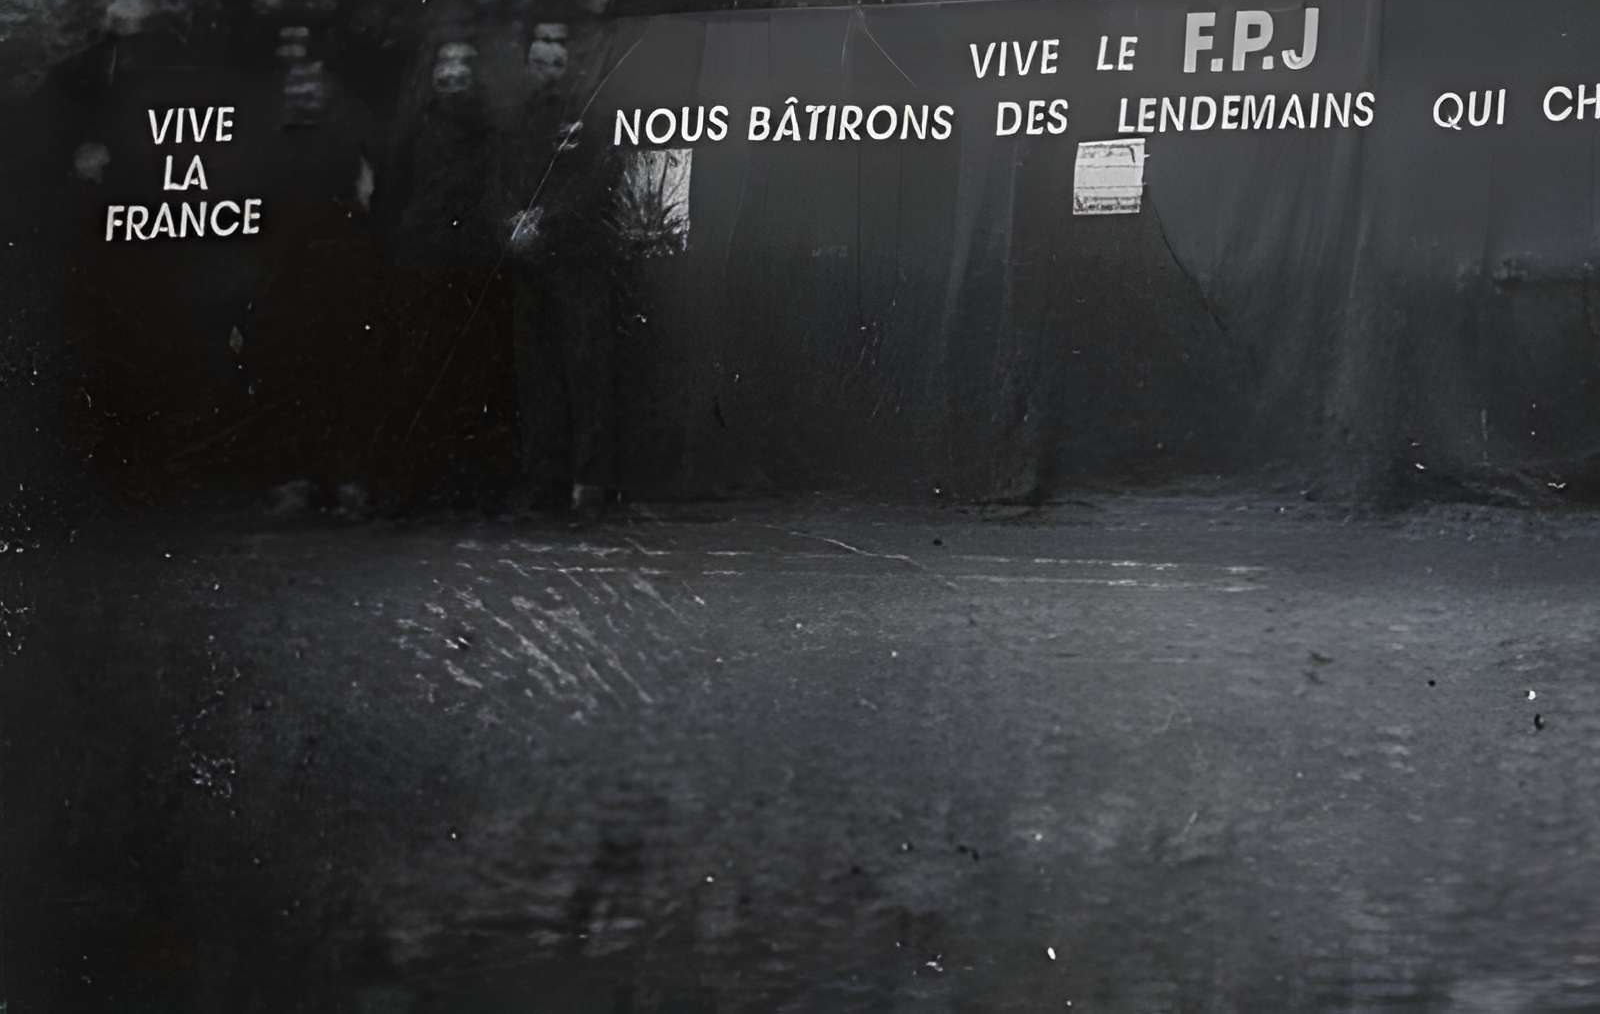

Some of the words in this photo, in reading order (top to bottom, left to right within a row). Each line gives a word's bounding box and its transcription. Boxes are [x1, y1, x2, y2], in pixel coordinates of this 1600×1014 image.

[969, 38, 1060, 79] VIVE
[1096, 35, 1138, 71] LE
[1183, 7, 1320, 74] F.P.J
[148, 106, 235, 145] VIVE
[613, 105, 729, 146] NOUS
[746, 95, 954, 142] BÂTIRONS
[995, 98, 1069, 136] DES
[1117, 91, 1376, 133] LENDEMAINS
[1432, 88, 1506, 131] QUI
[163, 154, 209, 191] LA
[105, 198, 262, 242] FRANCE
